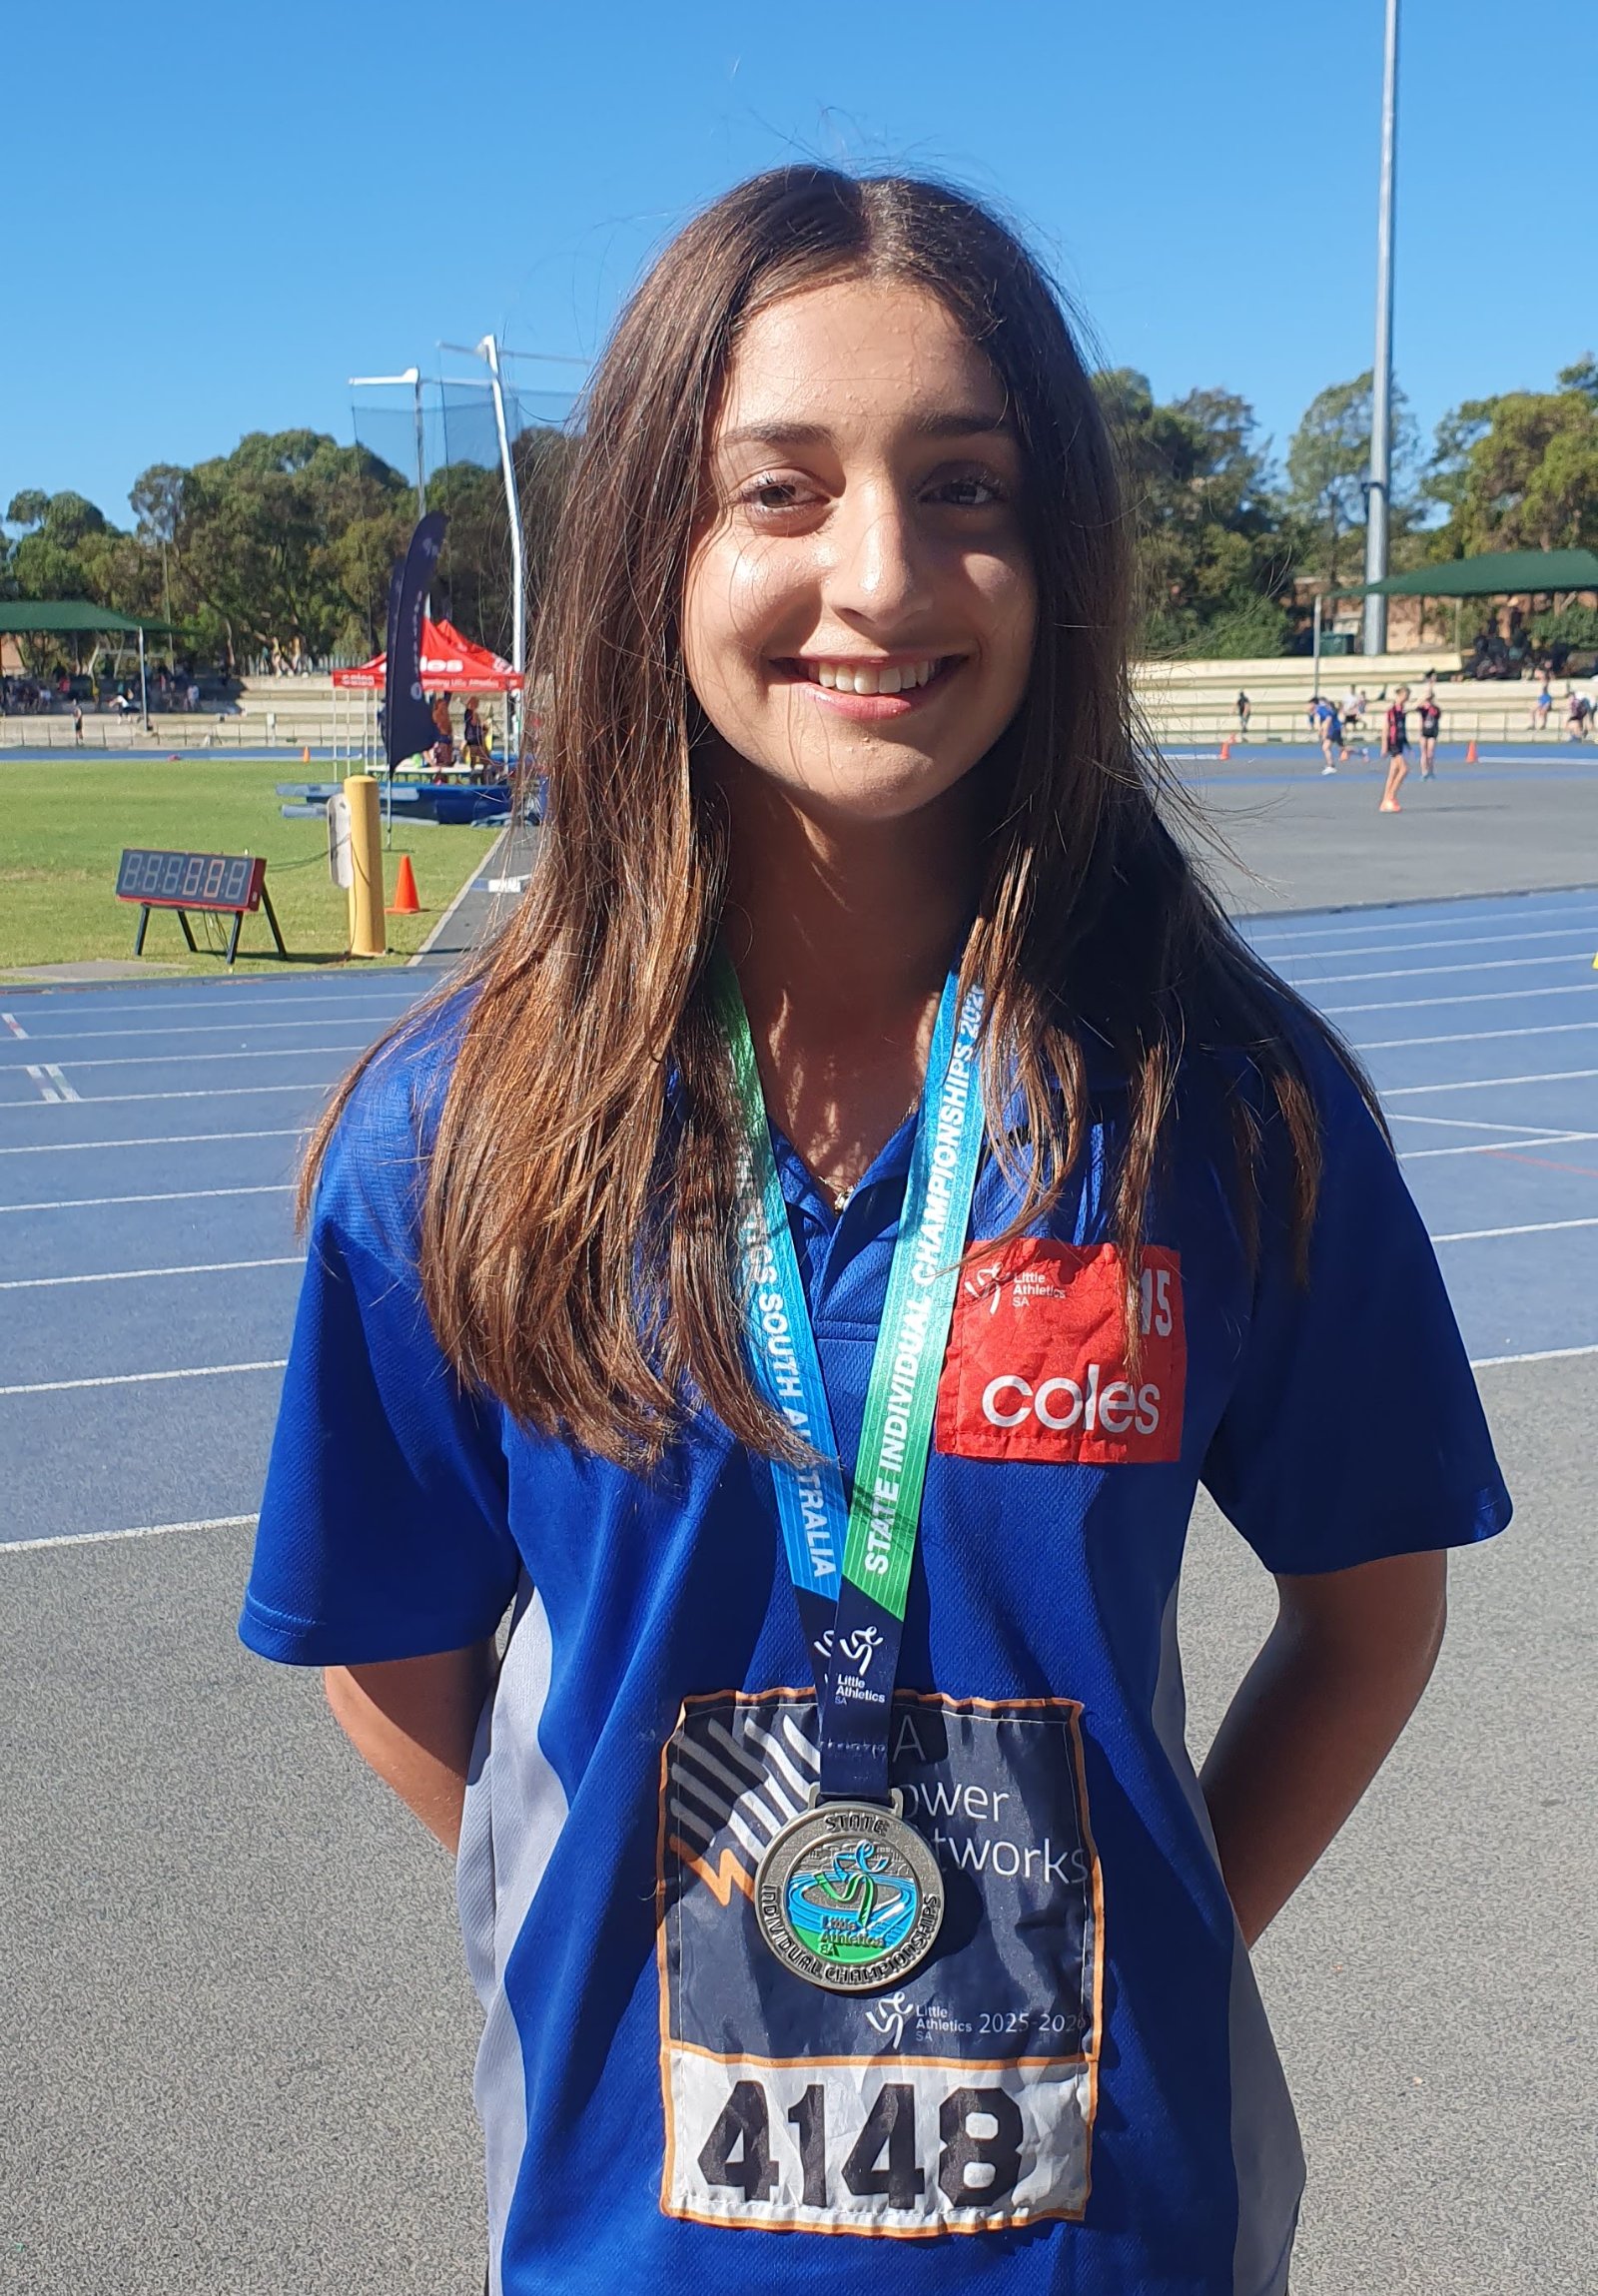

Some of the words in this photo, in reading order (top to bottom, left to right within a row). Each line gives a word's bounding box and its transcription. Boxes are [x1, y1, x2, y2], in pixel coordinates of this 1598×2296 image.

[912, 1041, 975, 1287] CHAMPIONSHIPS
[1012, 1284, 1066, 1298] Athletics
[1014, 1272, 1046, 1283] Little
[1012, 1297, 1030, 1307] SA
[879, 1295, 932, 1472] INDIVIDUAL
[982, 1364, 1161, 1435] coles
[759, 1292, 803, 1397] SOUTH
[782, 1405, 837, 1578] ATRALIA
[864, 1475, 899, 1575] STATE
[835, 1685, 886, 1704] Athletics
[837, 1674, 866, 1689] Little
[892, 1715, 926, 1763] A
[898, 1782, 1010, 1823] ower
[825, 1812, 890, 1837] STATE
[931, 1828, 1089, 1885] tworks
[761, 1885, 823, 1974] INDIVIDUAL
[825, 1894, 939, 1984] CHAMPIONSHIPS
[916, 2004, 948, 2018] Little
[916, 2018, 973, 2032] Athletics
[916, 2031, 933, 2041] SA
[697, 2079, 1024, 2209] 4148
